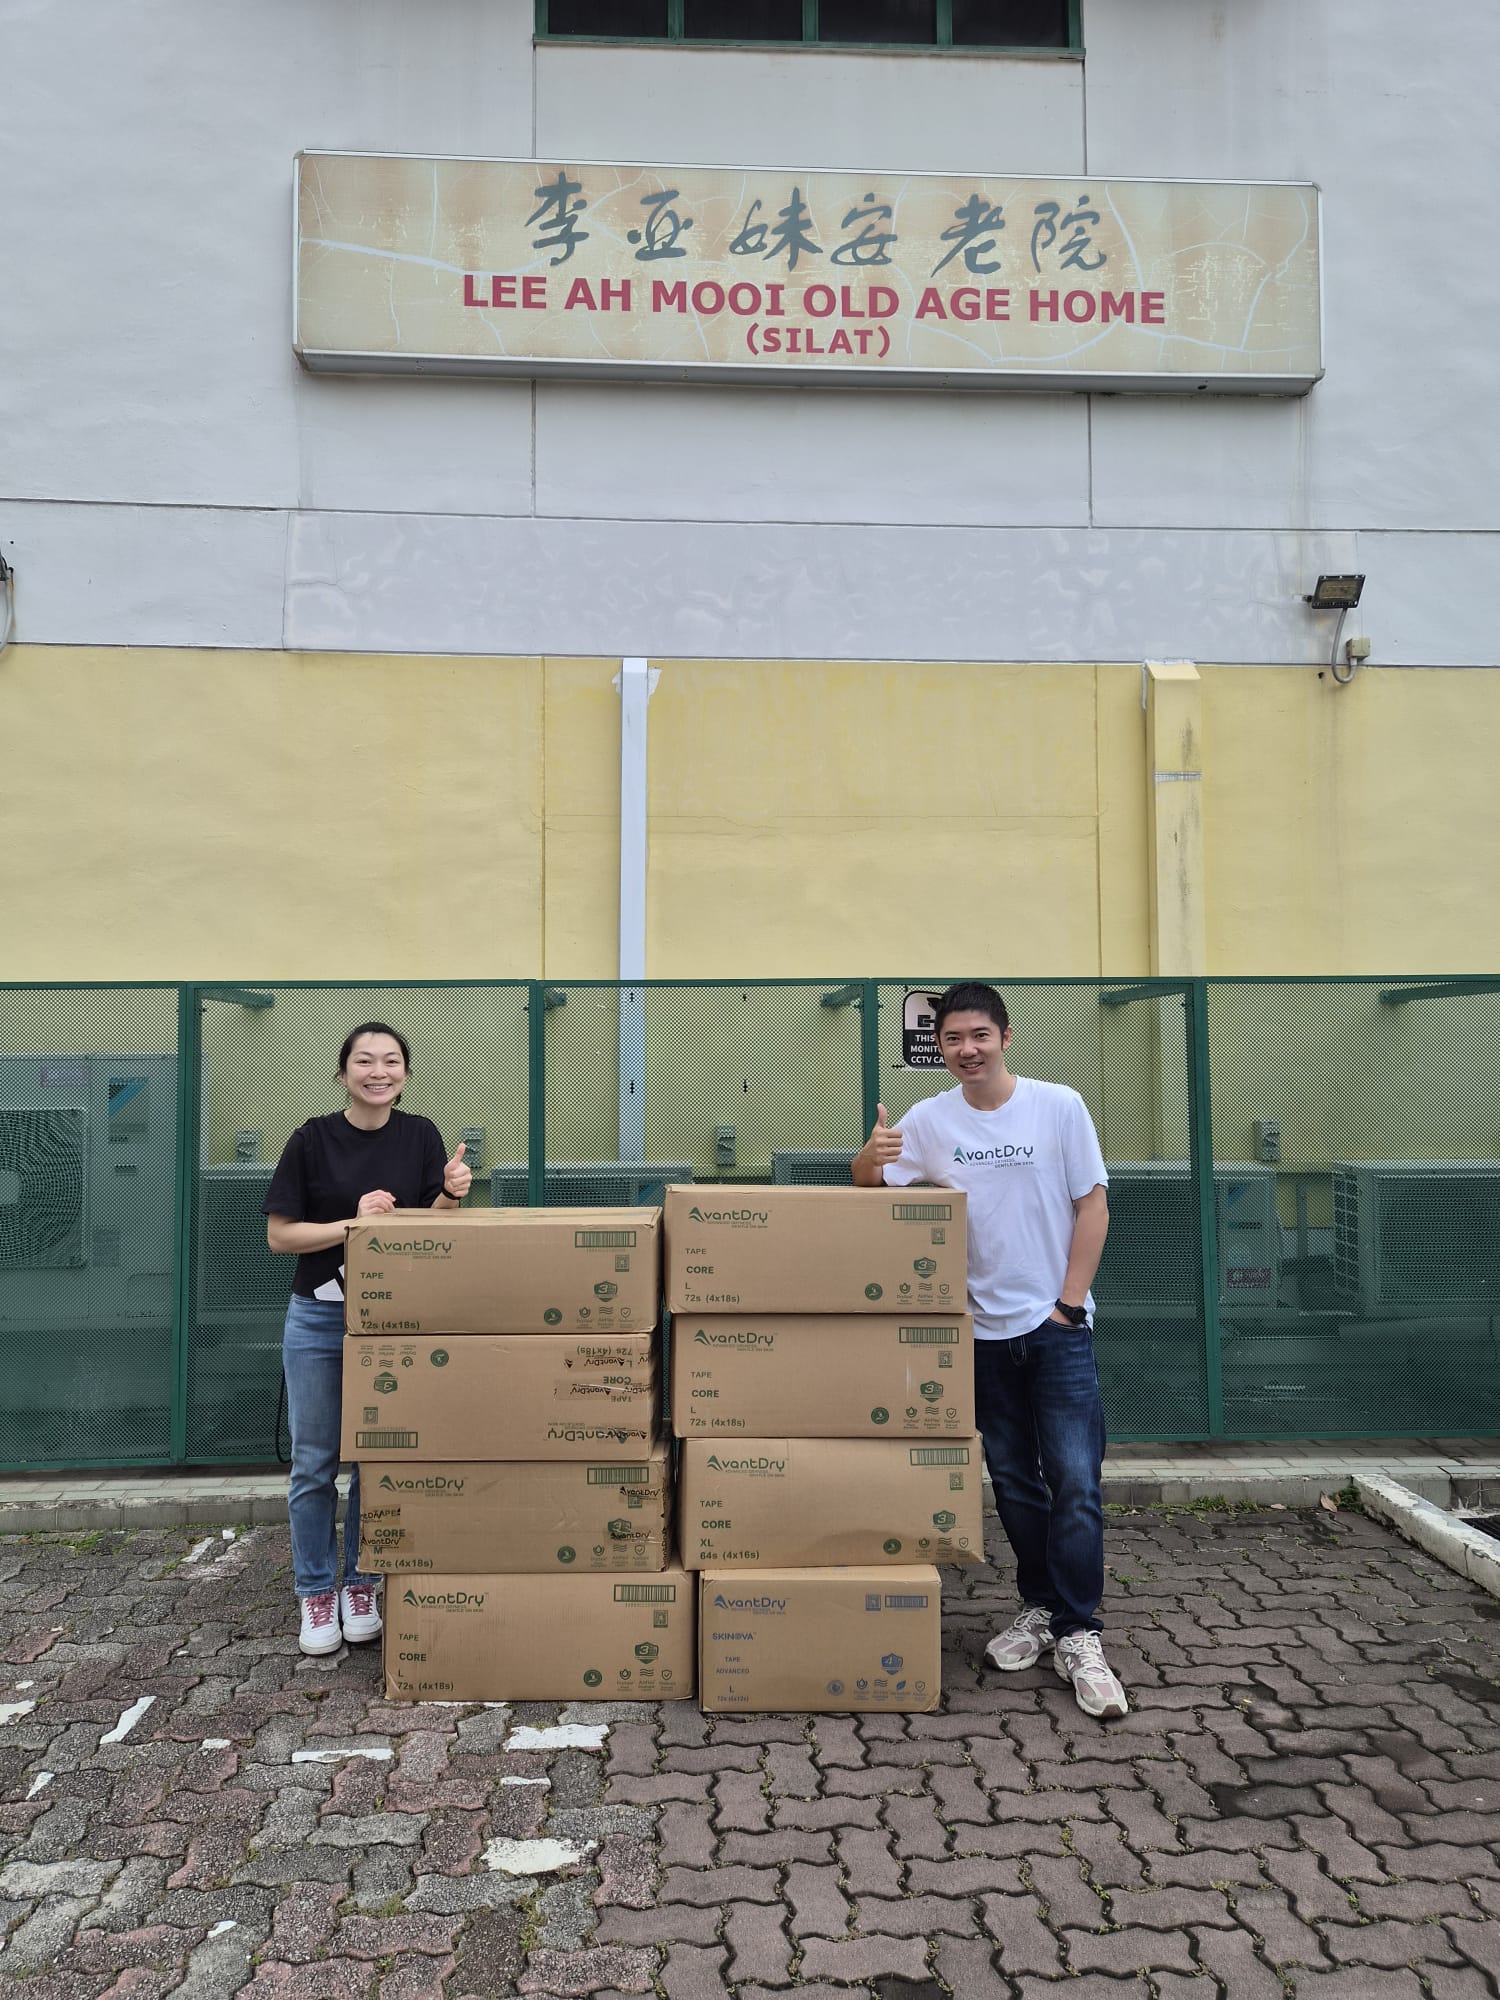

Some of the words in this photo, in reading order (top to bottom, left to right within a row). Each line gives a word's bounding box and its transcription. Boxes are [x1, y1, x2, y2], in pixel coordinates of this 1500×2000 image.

[463, 275, 547, 309] LEE
[564, 278, 631, 312] AH
[652, 280, 785, 316] MOOI
[803, 284, 900, 319] OLD
[915, 287, 1010, 321] AGE
[1029, 290, 1165, 324] HOME
[746, 323, 890, 358] (SILAT)
[915, 1034, 935, 1042] THIS
[910, 1045, 940, 1053] MONIT
[911, 1056, 932, 1064] CCTV
[933, 1056, 945, 1064] CA
[953, 1145, 1034, 1165] AvantDry
[688, 1206, 768, 1223] AvantDry
[367, 1237, 452, 1254] AvantDry
[686, 1266, 714, 1274] CORE
[685, 1281, 691, 1289] L
[361, 1291, 392, 1299] CORE
[685, 1294, 701, 1302] 72s
[705, 1294, 740, 1304] (4x18s)
[360, 1308, 369, 1316] M
[361, 1321, 378, 1329] 72s
[694, 1329, 774, 1347] AvantDry
[603, 1376, 632, 1384] CORE
[691, 1390, 719, 1398] CORE
[690, 1406, 696, 1414] L
[690, 1418, 707, 1426] 72s
[711, 1418, 745, 1428] (4x18s)
[707, 1455, 785, 1472] AvantDry
[379, 1475, 464, 1492] AvantDry
[701, 1520, 731, 1528] CORE
[374, 1529, 406, 1537] CORE
[700, 1539, 714, 1547] XL
[700, 1551, 718, 1560] 64s
[722, 1551, 760, 1560] (4x16s)
[373, 1560, 392, 1568] 72s
[395, 1559, 434, 1568] (4x18s)
[403, 1589, 484, 1607] AvantDry
[714, 1594, 786, 1610] AvantDry
[398, 1633, 419, 1641] TAPE
[399, 1652, 427, 1661] CORE
